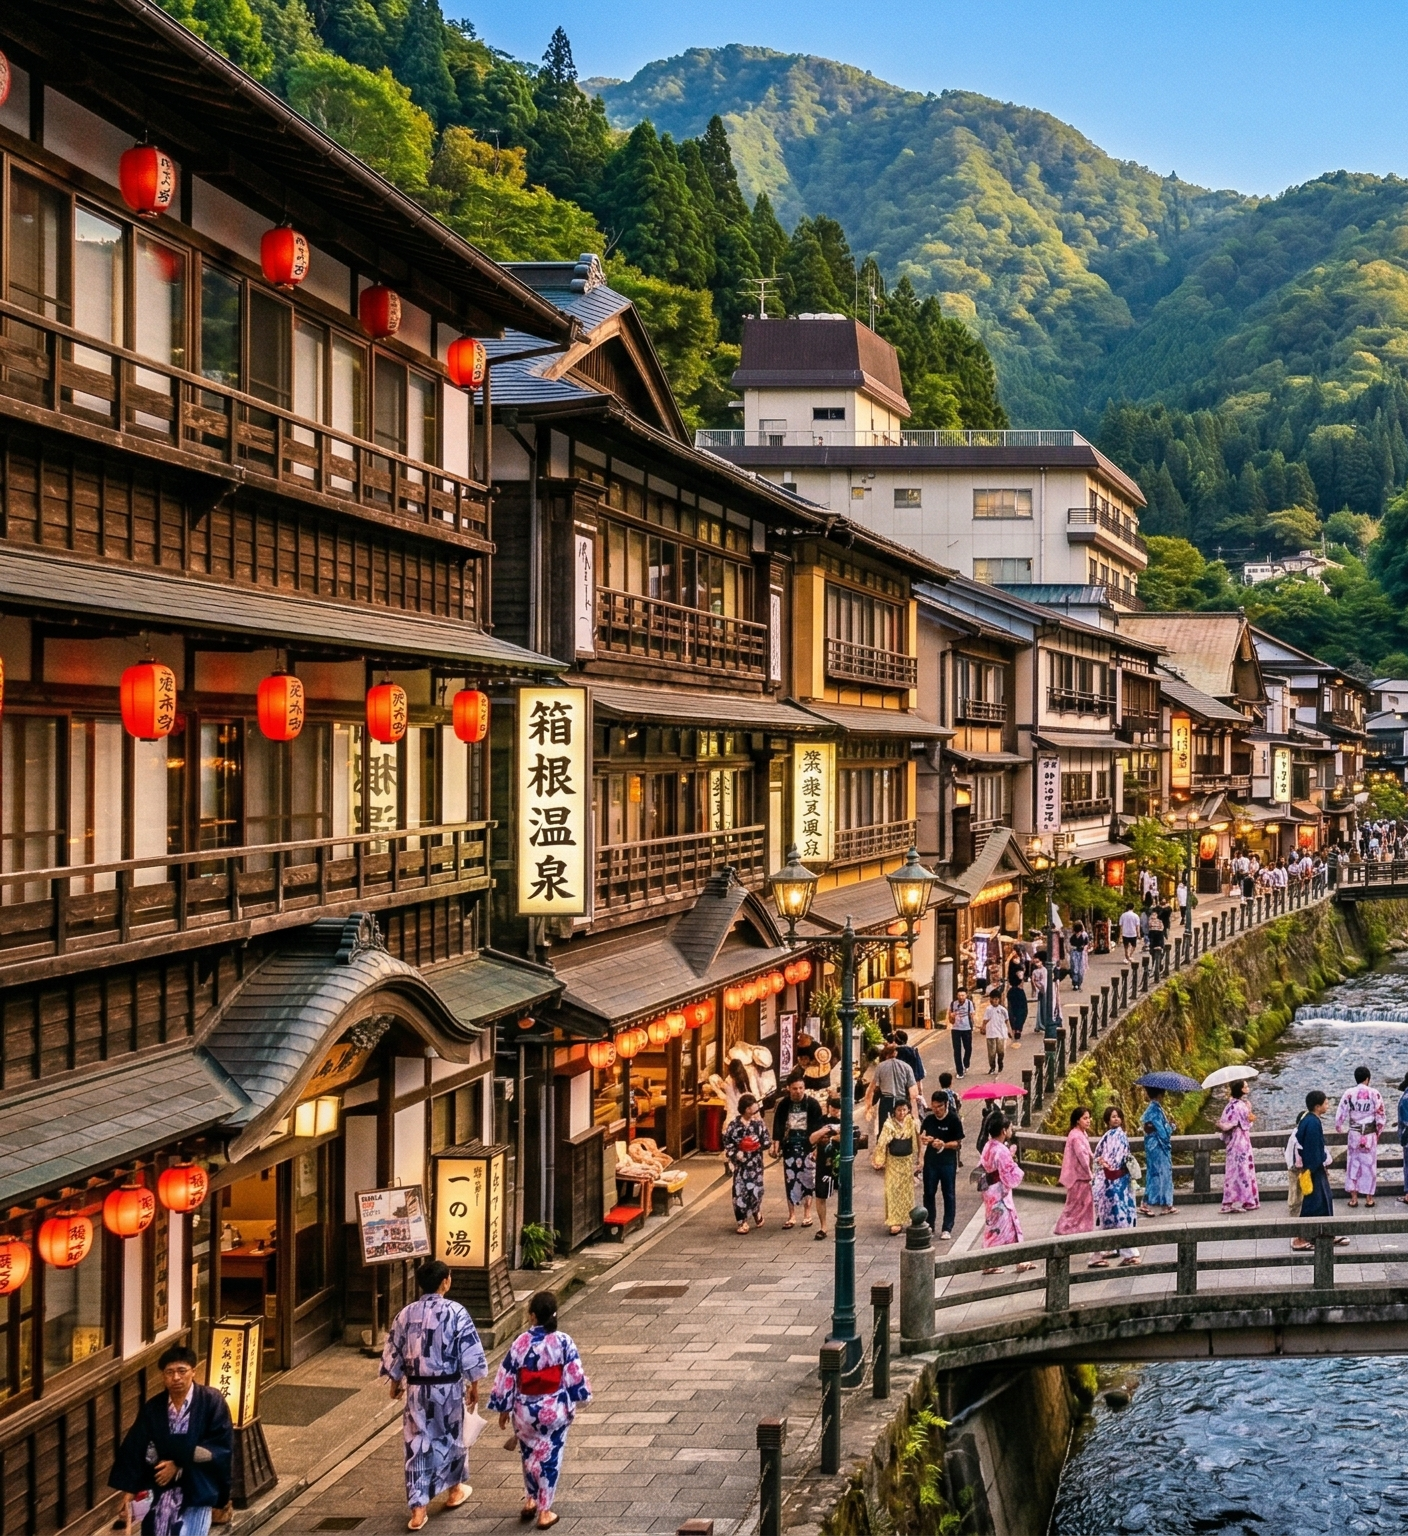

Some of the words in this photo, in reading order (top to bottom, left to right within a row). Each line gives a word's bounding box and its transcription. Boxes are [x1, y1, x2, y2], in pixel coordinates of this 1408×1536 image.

[527, 700, 577, 902] 箱根温泉
[445, 1175, 472, 1258] 一の湯
